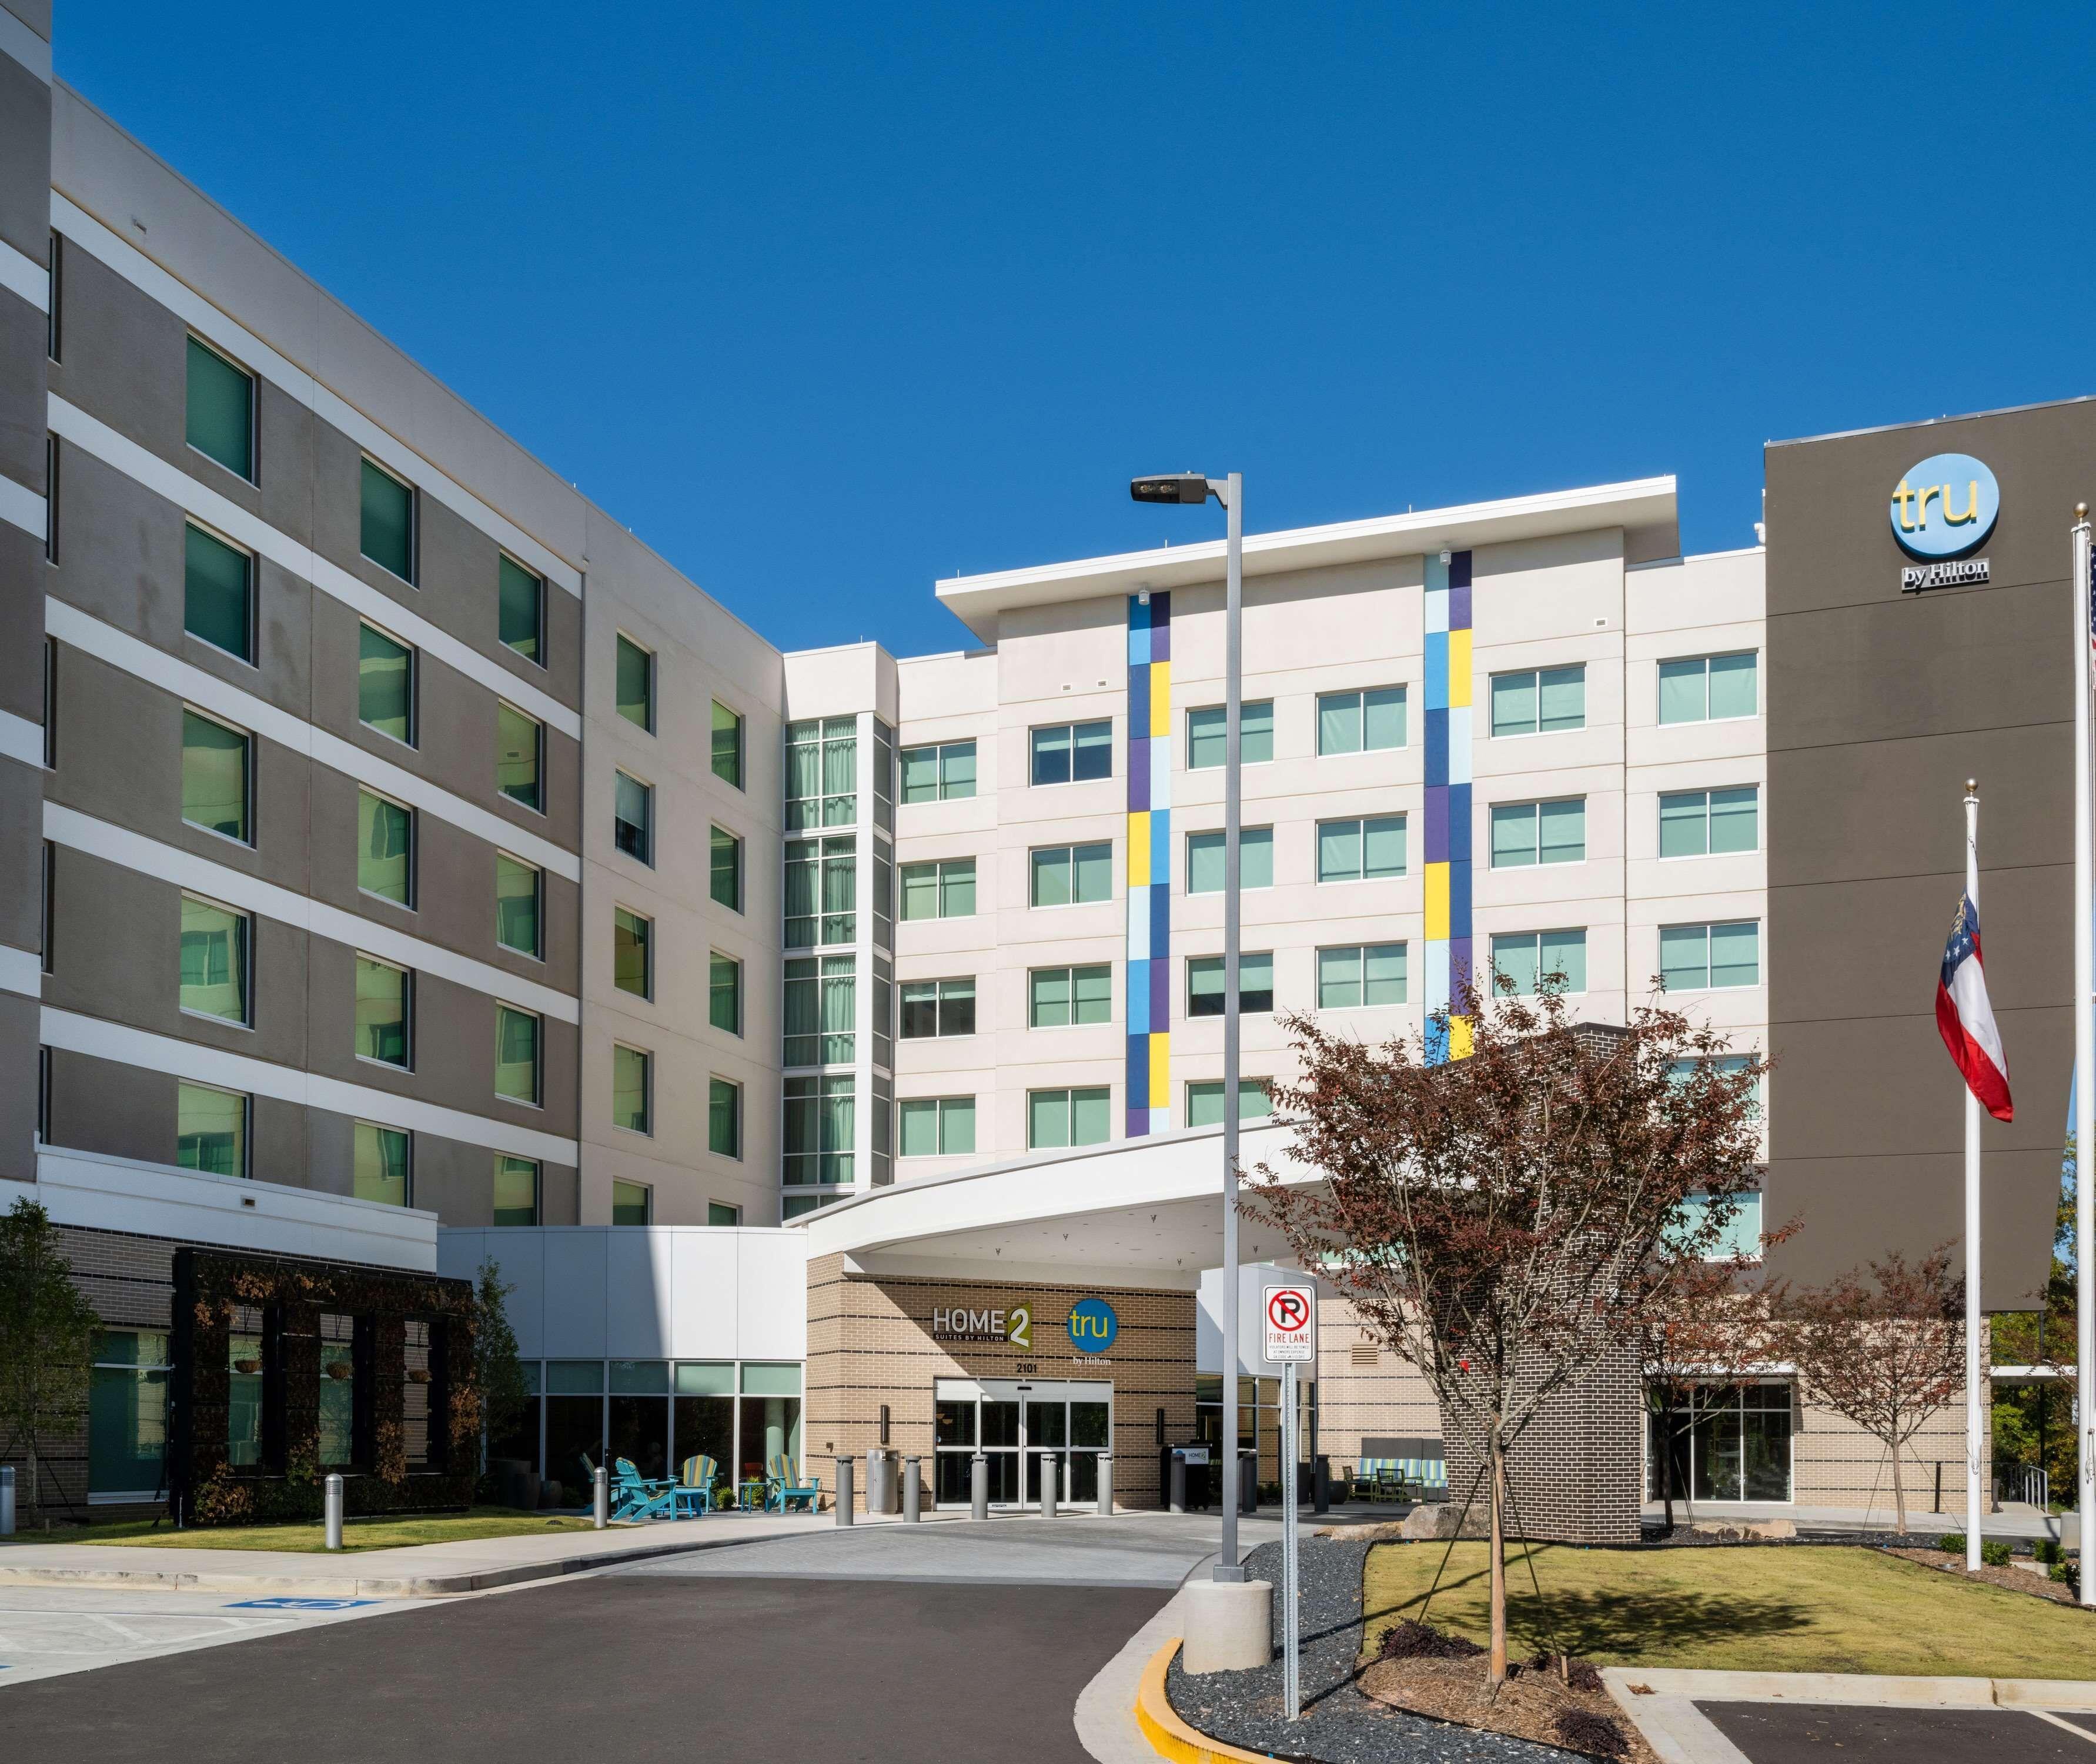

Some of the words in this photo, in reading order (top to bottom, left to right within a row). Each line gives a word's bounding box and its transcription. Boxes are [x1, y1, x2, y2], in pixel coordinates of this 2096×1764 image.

[1893, 479, 1978, 532] tru
[1904, 567, 1927, 585] by
[1931, 560, 1989, 579] Hilton
[1069, 1310, 1108, 1338] tru
[1269, 1333, 1286, 1343] FIRE
[1289, 1333, 1310, 1343] LANE
[1017, 1364, 1037, 1374] 2101
[1073, 1356, 1083, 1367] by
[1085, 1357, 1111, 1365] Hilton
